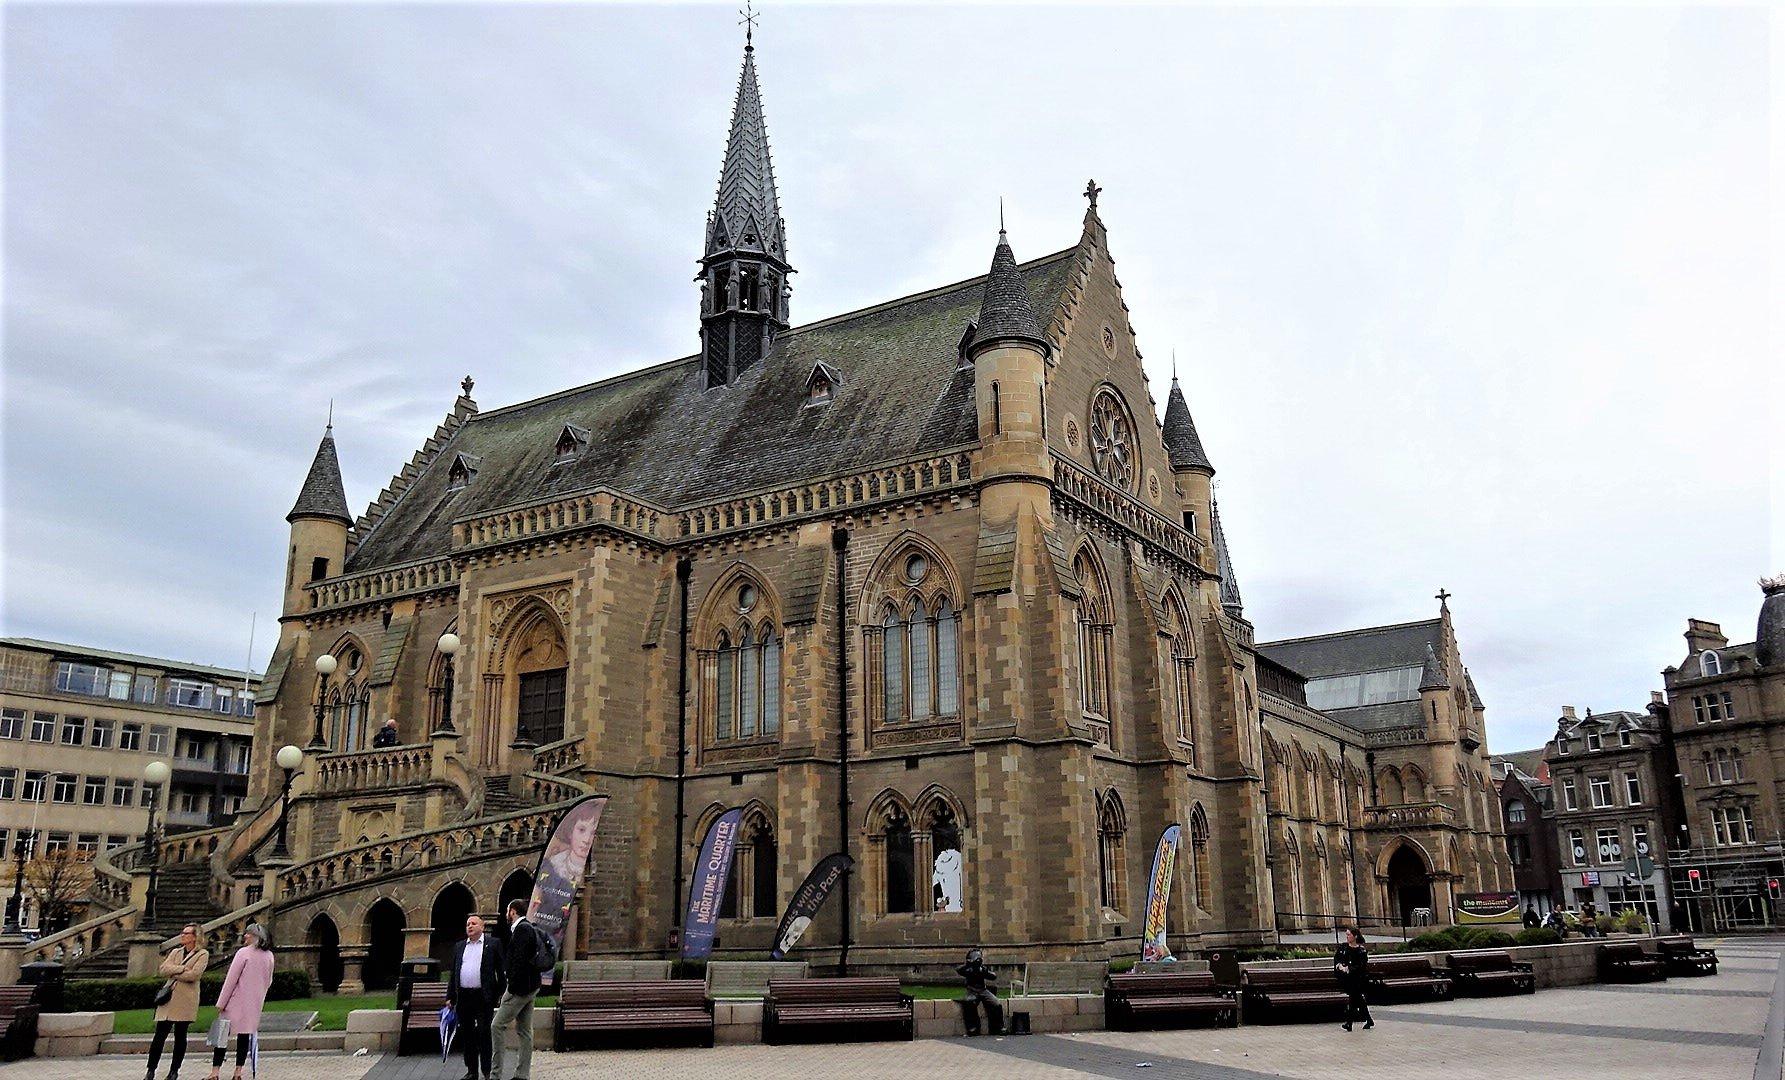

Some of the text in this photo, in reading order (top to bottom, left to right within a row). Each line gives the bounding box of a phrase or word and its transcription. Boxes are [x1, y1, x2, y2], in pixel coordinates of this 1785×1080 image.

[697, 874, 716, 923] MARITIME
[709, 821, 730, 871] QUARTER
[807, 866, 841, 912] the Past
[692, 900, 700, 913] THE
[797, 883, 816, 908] with
